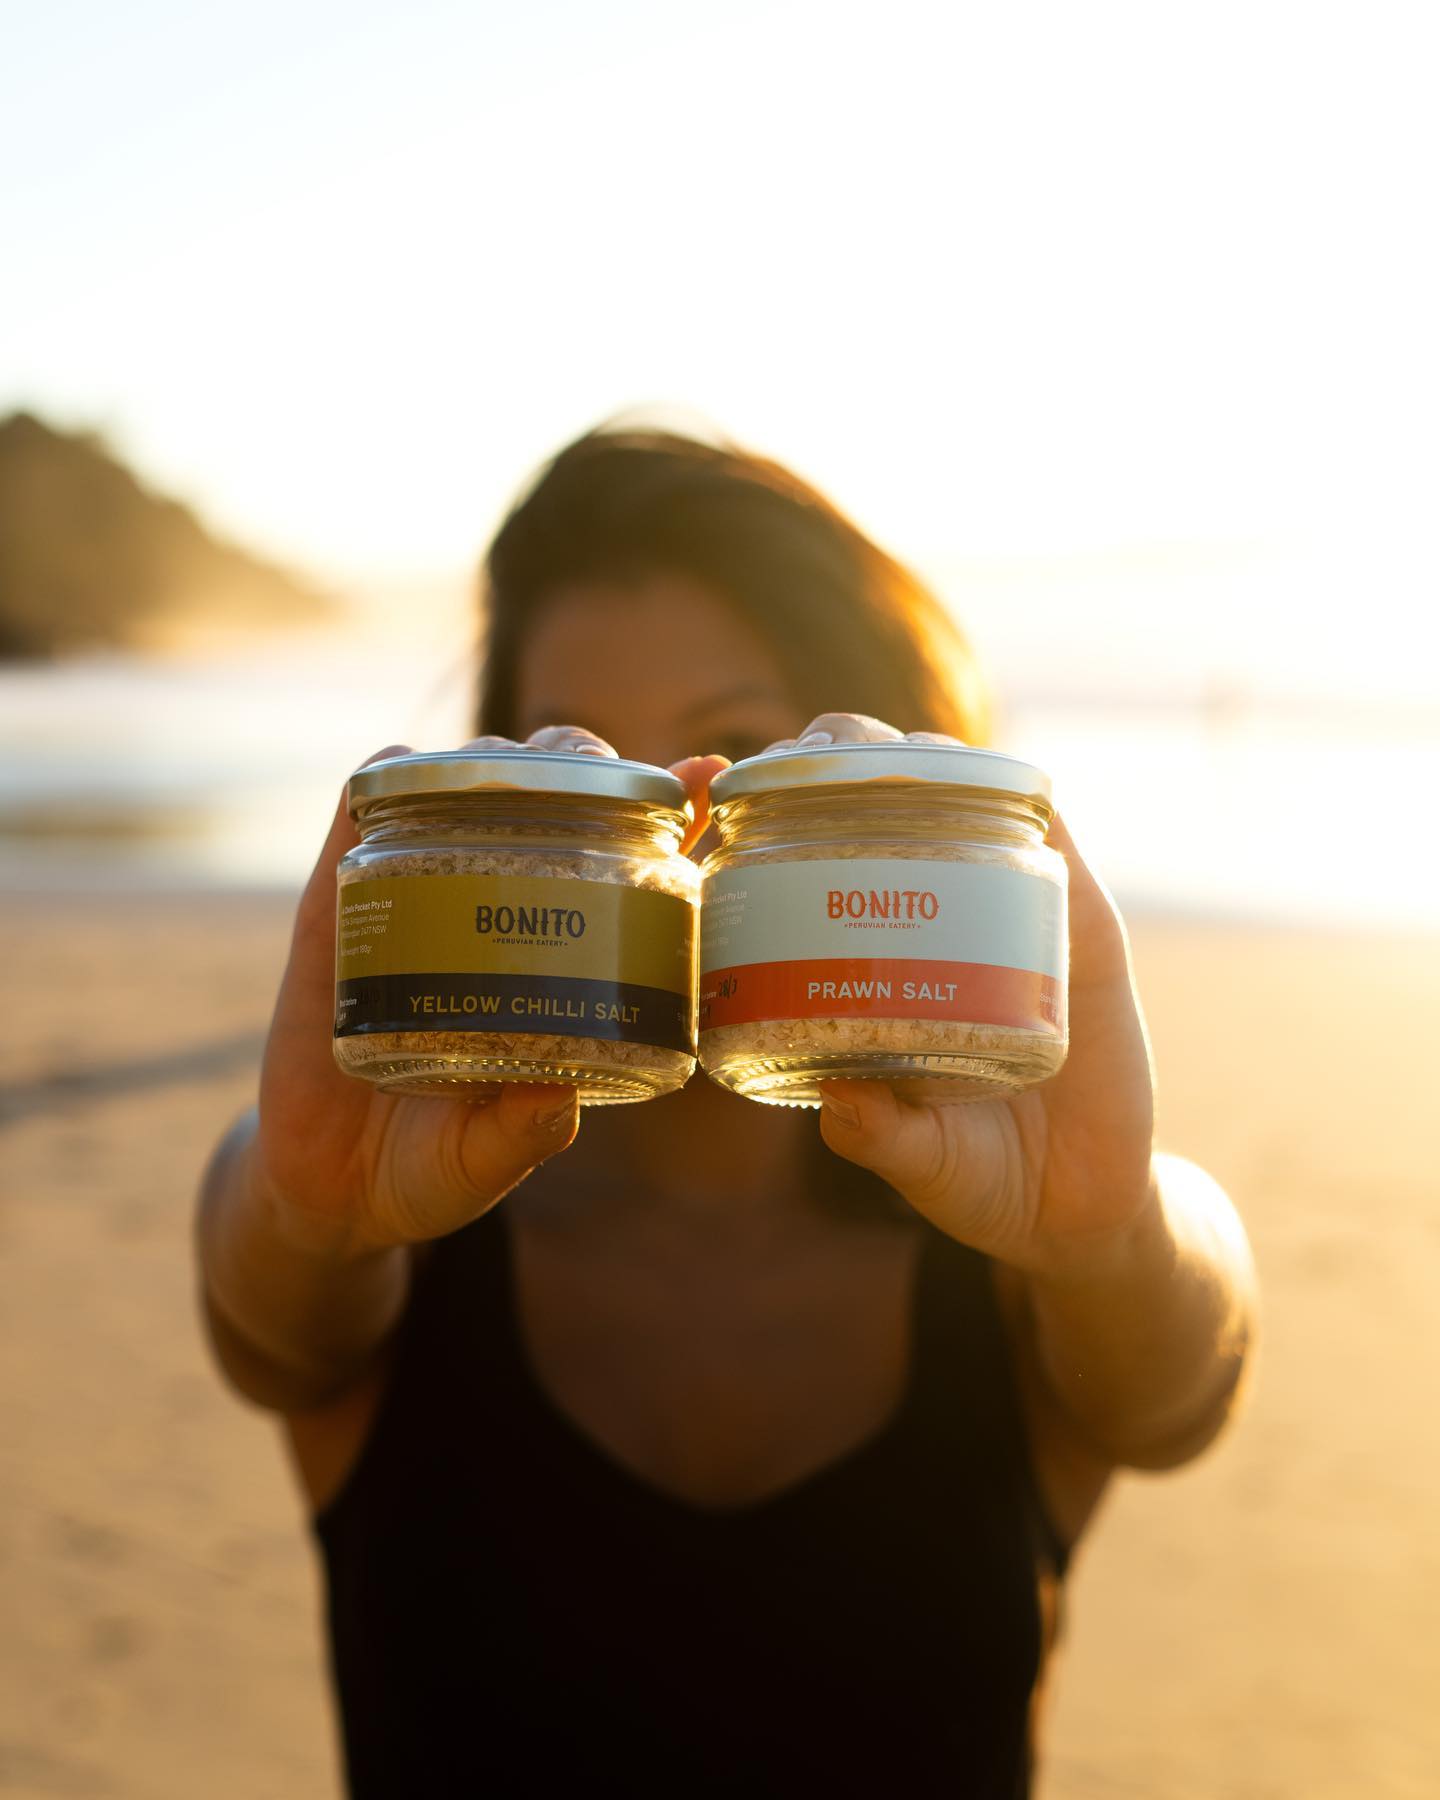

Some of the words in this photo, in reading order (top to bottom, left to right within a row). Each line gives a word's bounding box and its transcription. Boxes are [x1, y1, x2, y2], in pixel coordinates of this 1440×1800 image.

[371, 901, 380, 910] Pty
[381, 899, 392, 909] Ltd
[827, 890, 940, 921] BONITO
[368, 914, 390, 922] Avenue
[475, 905, 586, 938] BONITO
[373, 925, 387, 934] NSW
[807, 981, 892, 1000] PRAWN
[902, 982, 958, 1001] SALT
[409, 996, 501, 1014] YELLOW
[511, 997, 585, 1018] CHILLI
[594, 1002, 641, 1024] SALT
